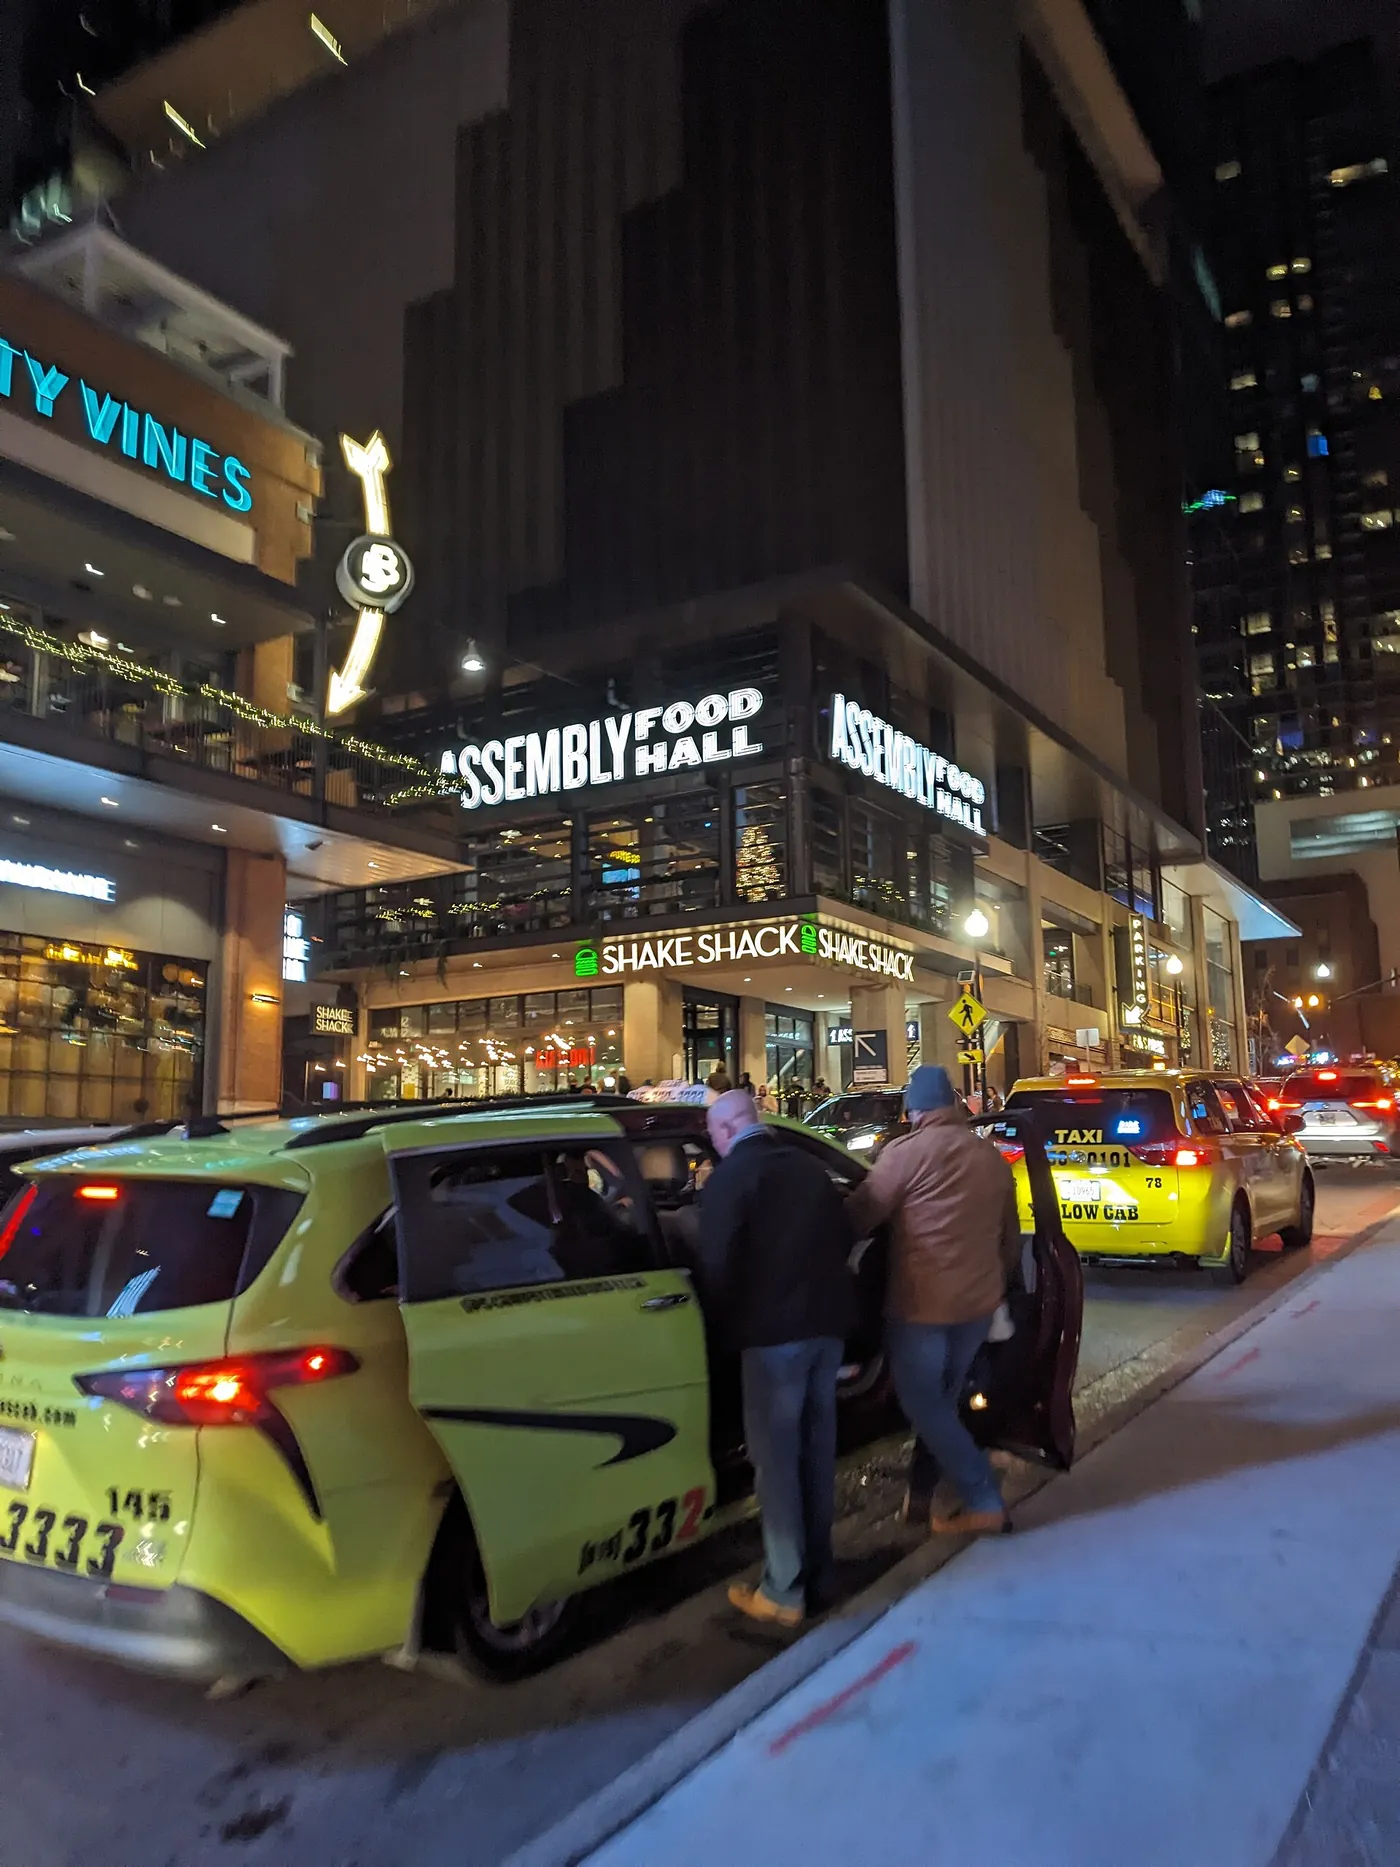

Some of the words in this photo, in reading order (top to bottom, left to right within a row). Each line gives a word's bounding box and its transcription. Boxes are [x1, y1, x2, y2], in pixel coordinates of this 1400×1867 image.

[80, 378, 253, 513] VINES
[634, 687, 764, 742] FOOD
[436, 710, 635, 811] ASSEMBLY
[634, 725, 764, 776] HALL
[831, 692, 936, 808] ASSEMBLY
[934, 754, 986, 805] FOOD
[936, 785, 988, 838] HALL
[601, 936, 694, 974] SHAKE
[697, 923, 801, 964] SHACK
[817, 927, 869, 969] SHAKE
[867, 947, 915, 983] SHACK
[1132, 918, 1147, 1004] PARKING
[315, 1019, 354, 1035] SHACK
[316, 1005, 353, 1020] SHAKE
[1054, 1128, 1103, 1144] TAXI
[1087, 1151, 1131, 1168] 0101
[1145, 1177, 1163, 1189] 78
[1103, 1204, 1140, 1221] CAB
[105, 1485, 173, 1522] 145
[0, 1500, 126, 1578] 3333
